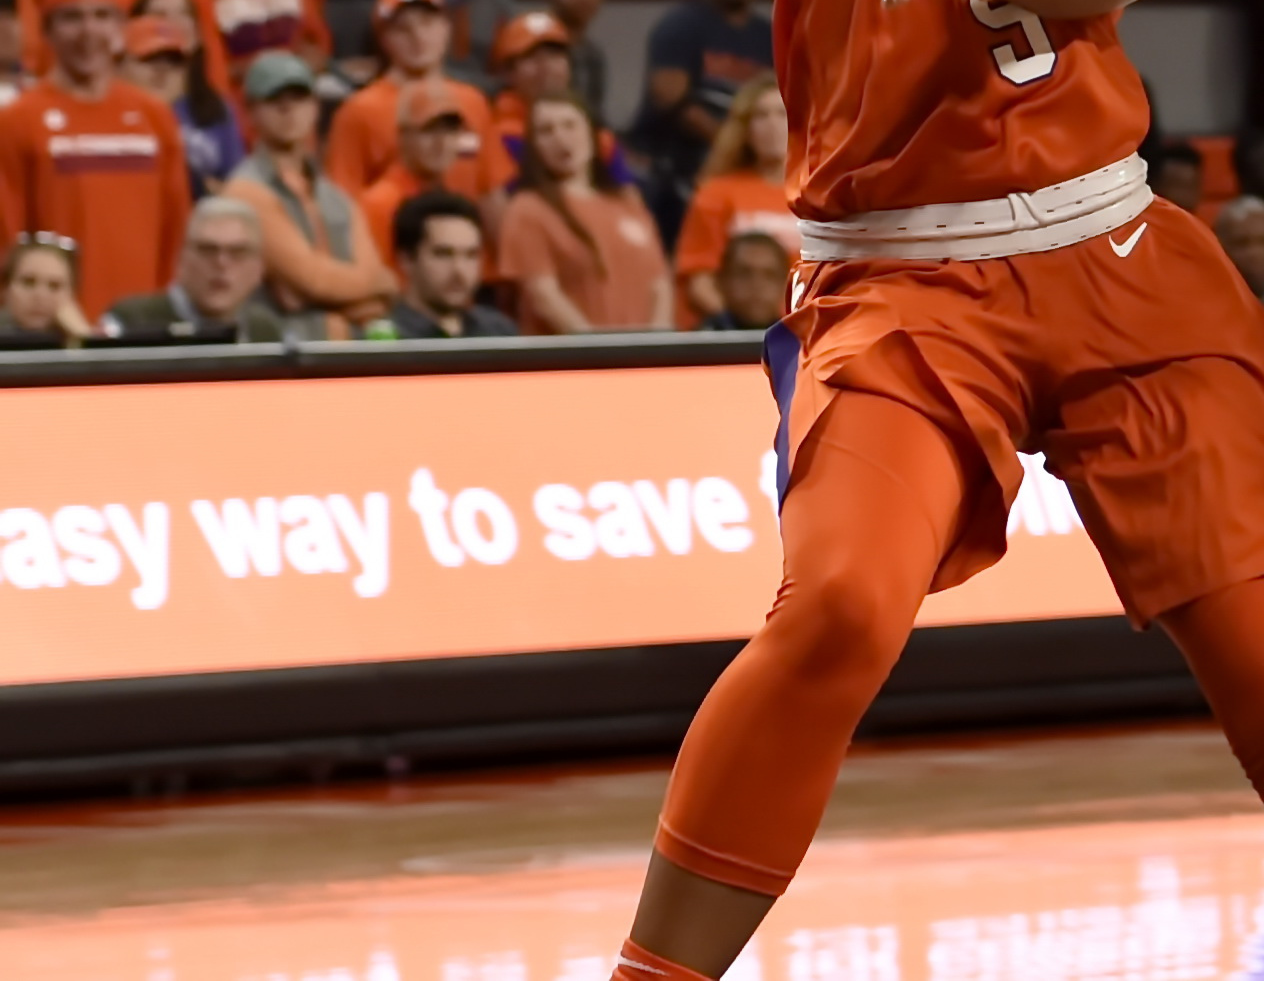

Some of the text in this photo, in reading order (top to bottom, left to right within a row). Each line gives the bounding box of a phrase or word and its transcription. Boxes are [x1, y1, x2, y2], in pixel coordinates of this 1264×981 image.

[0, 467, 754, 610] asy way to save
